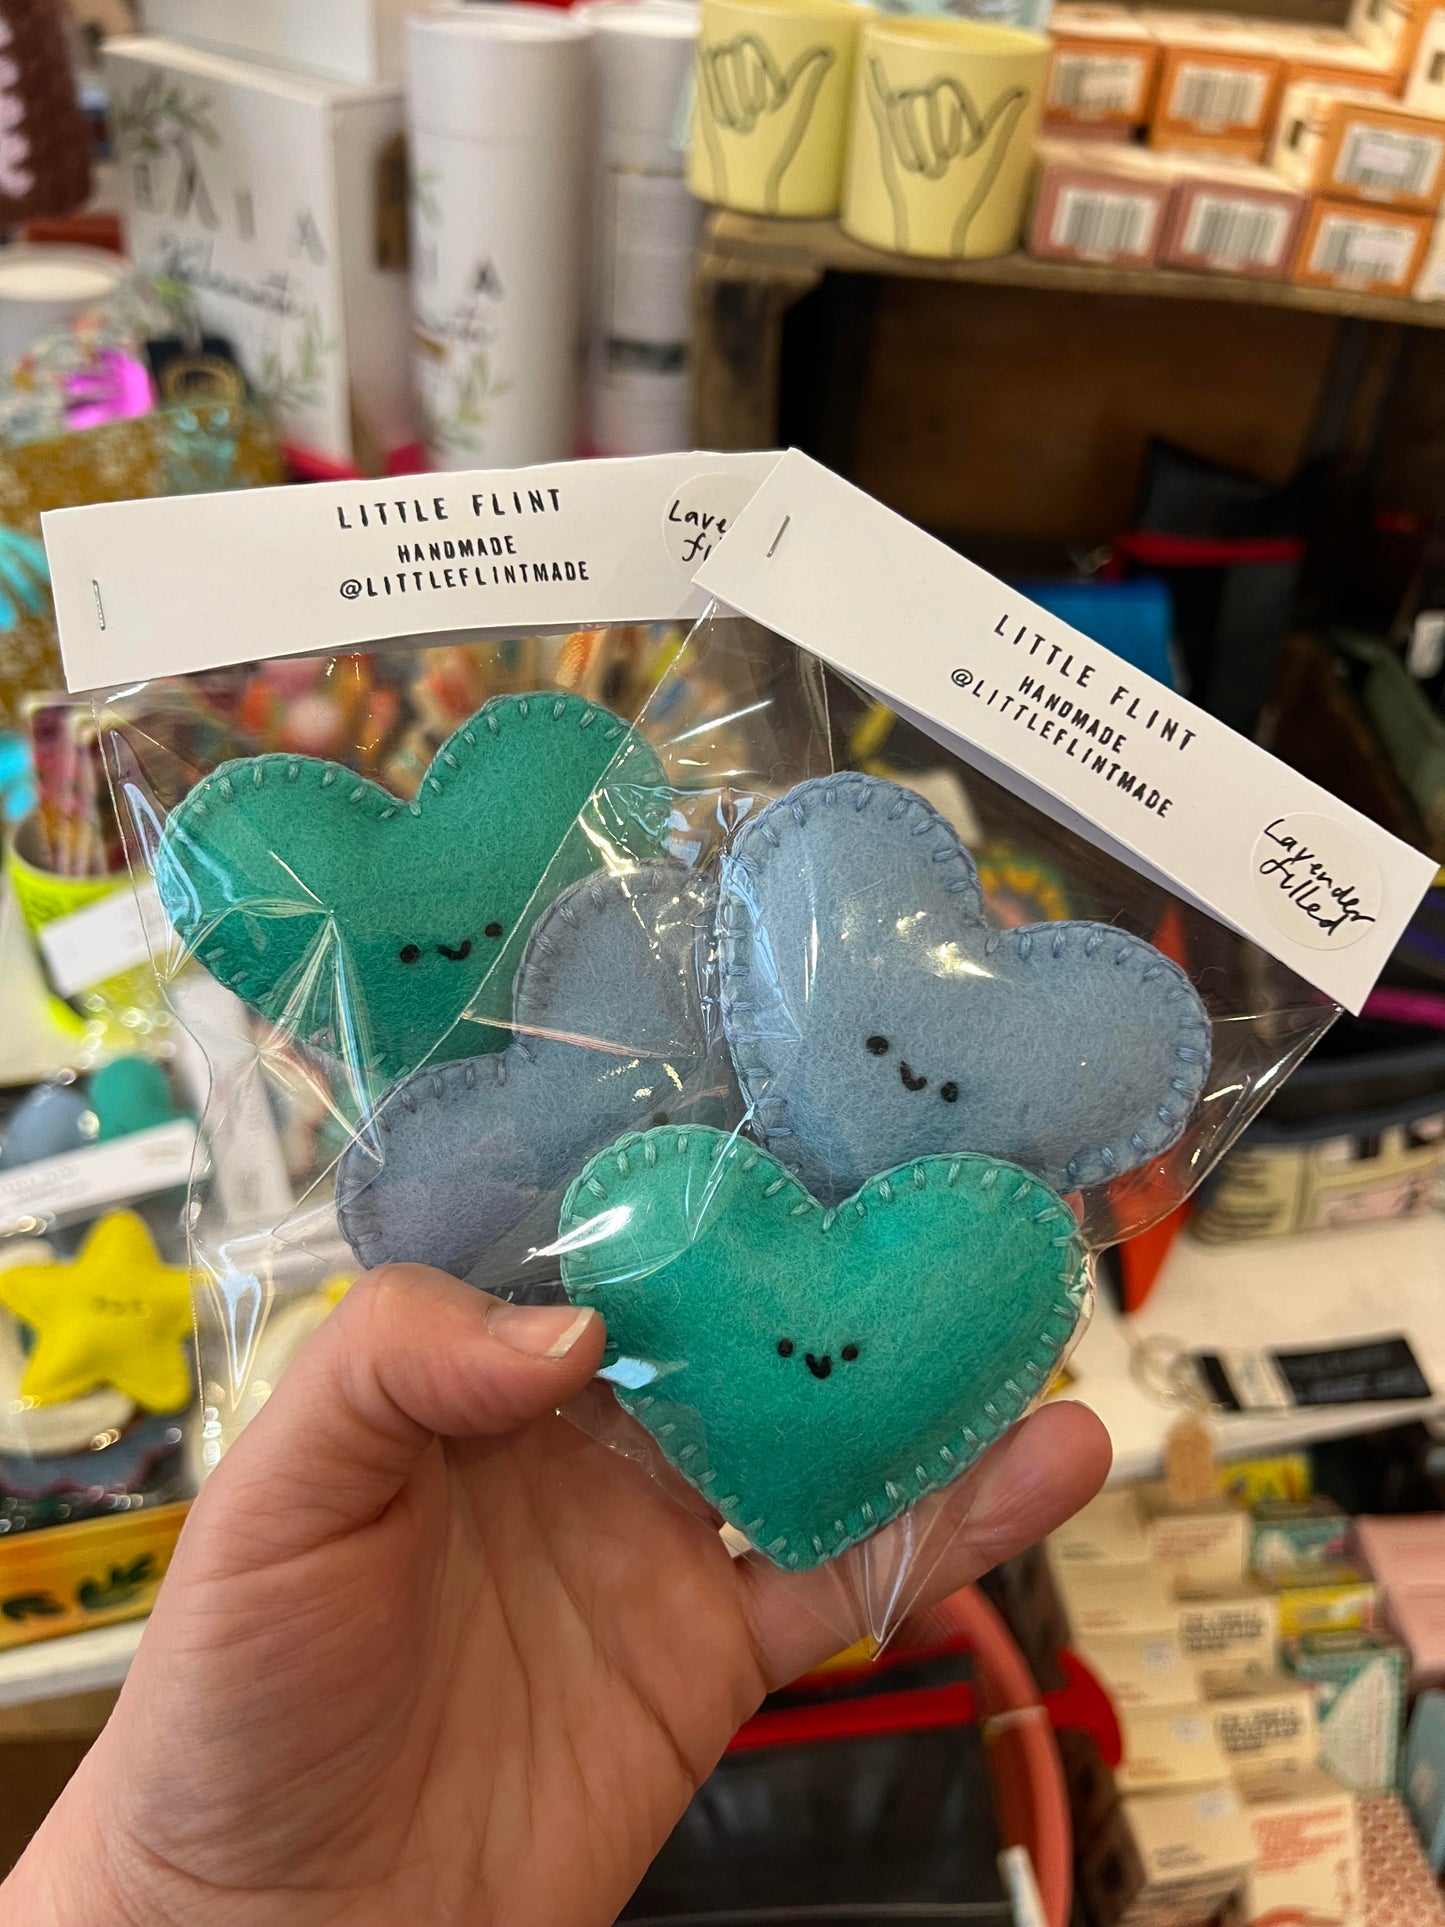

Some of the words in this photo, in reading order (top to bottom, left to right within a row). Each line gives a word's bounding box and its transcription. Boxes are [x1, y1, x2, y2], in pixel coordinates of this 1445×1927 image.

[336, 496, 449, 530] LITTLE
[471, 487, 561, 518] FLINT
[396, 534, 518, 564] HANDMADE
[667, 498, 728, 535] Lave
[338, 560, 590, 600] @LITTLEFLINTMADE
[993, 613, 1097, 689] LITTLE
[1109, 685, 1197, 752] FLINT
[1017, 674, 1128, 755] HANDMADE
[950, 667, 1174, 819] @LITTLEFLINTMADE
[1259, 856, 1350, 937] filled
[1262, 817, 1377, 923] Lavender
